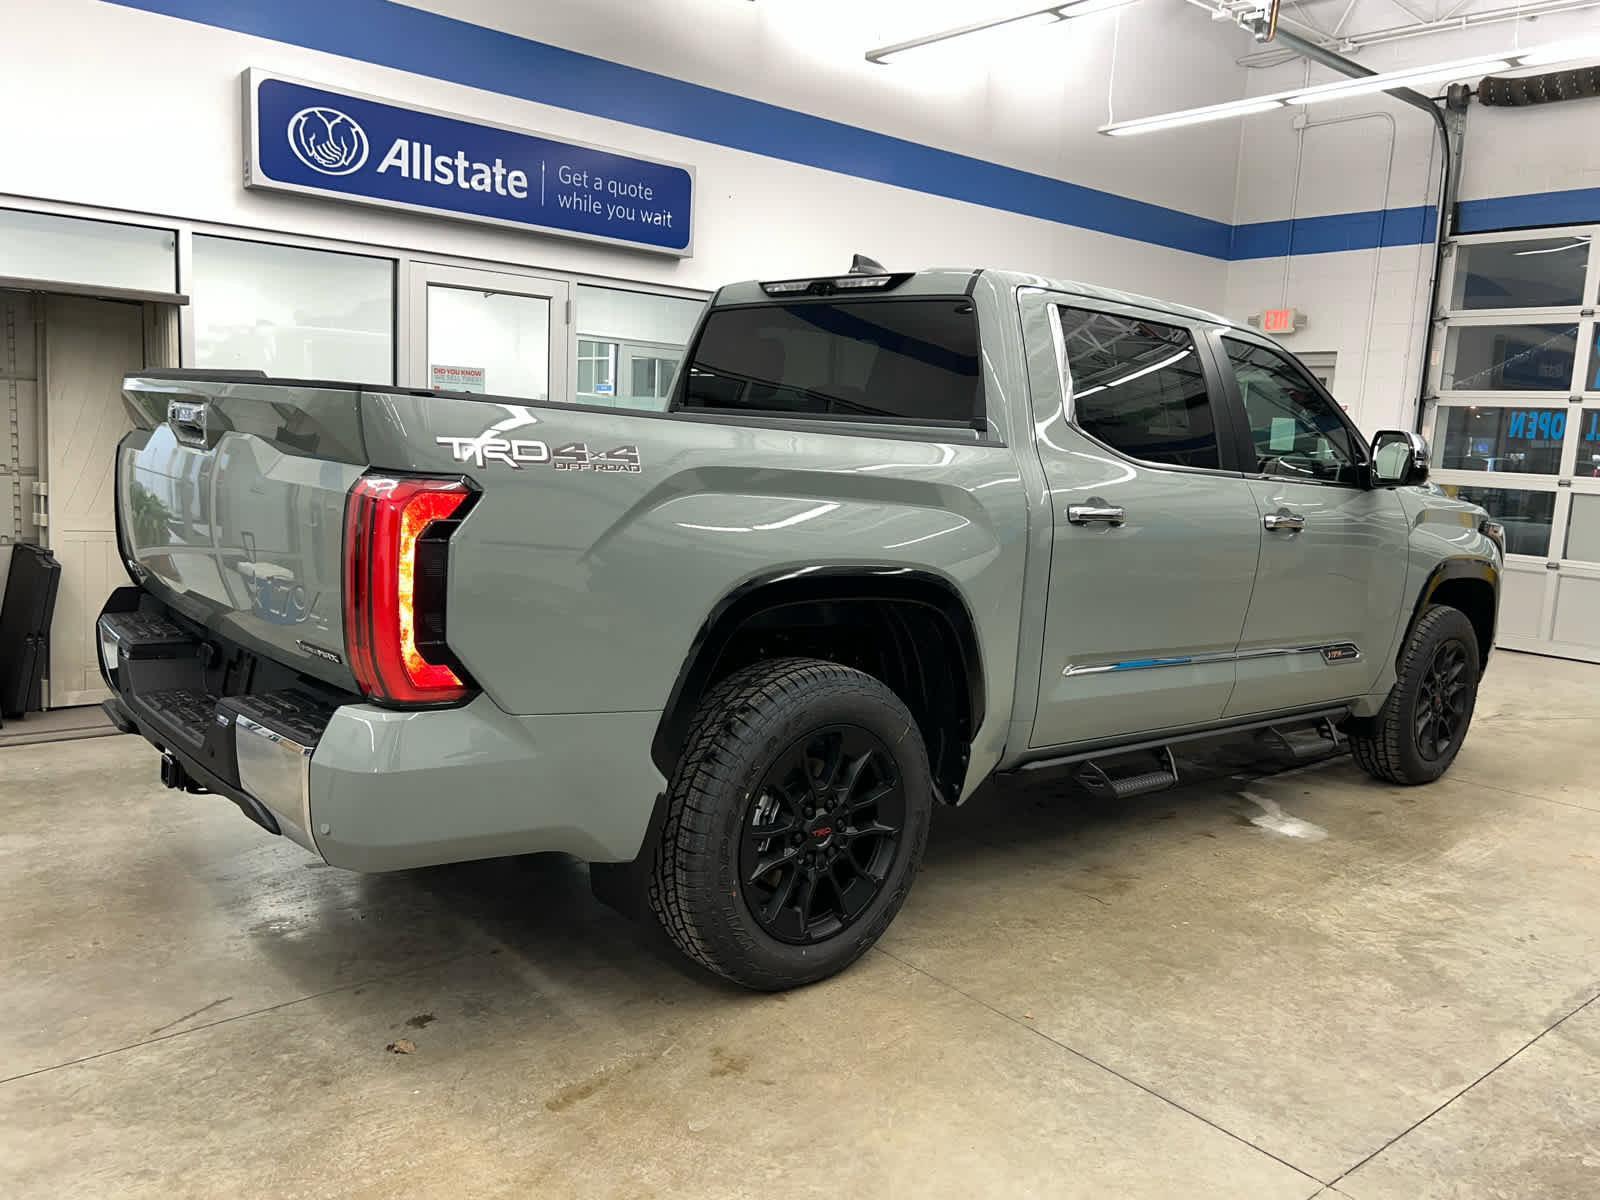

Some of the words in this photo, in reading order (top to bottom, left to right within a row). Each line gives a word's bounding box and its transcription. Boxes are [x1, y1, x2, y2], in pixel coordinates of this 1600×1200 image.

[376, 138, 528, 199] Allstate
[558, 165, 588, 189] Get
[593, 177, 603, 191] a
[607, 179, 653, 201] quote
[558, 191, 602, 215] while
[606, 203, 635, 221] you
[640, 209, 673, 229] wait
[1264, 310, 1290, 330] EXIT
[434, 367, 446, 375] DID
[447, 368, 461, 376] YOU
[461, 369, 482, 377] KNOW
[436, 436, 551, 470] TRD
[554, 462, 589, 472] OFF
[593, 464, 642, 474] ROAD
